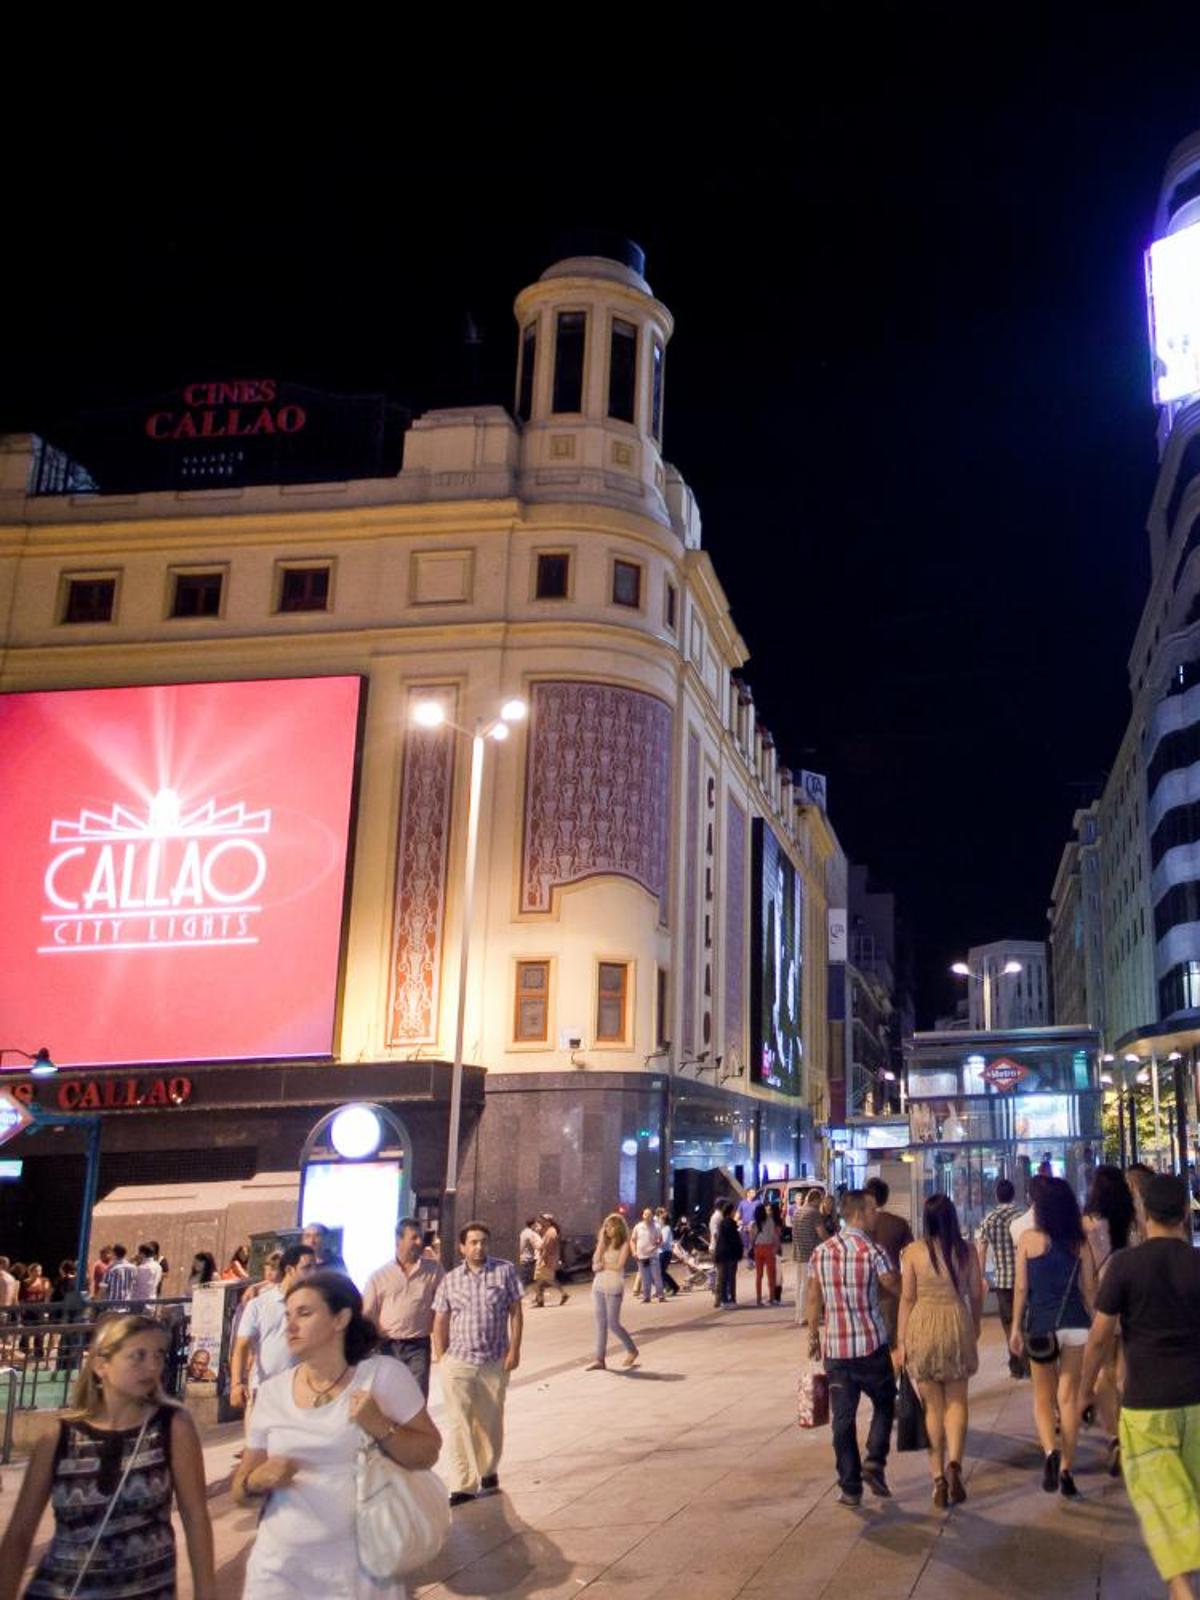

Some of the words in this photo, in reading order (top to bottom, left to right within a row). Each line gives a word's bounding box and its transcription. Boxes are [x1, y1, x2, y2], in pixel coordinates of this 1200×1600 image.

[183, 380, 276, 407] CINES
[145, 404, 307, 439] CALLAO
[44, 839, 267, 910] CALLAO
[54, 921, 126, 944] CITY
[148, 913, 248, 940] LIGHTS
[57, 1076, 192, 1110] CALLAO
